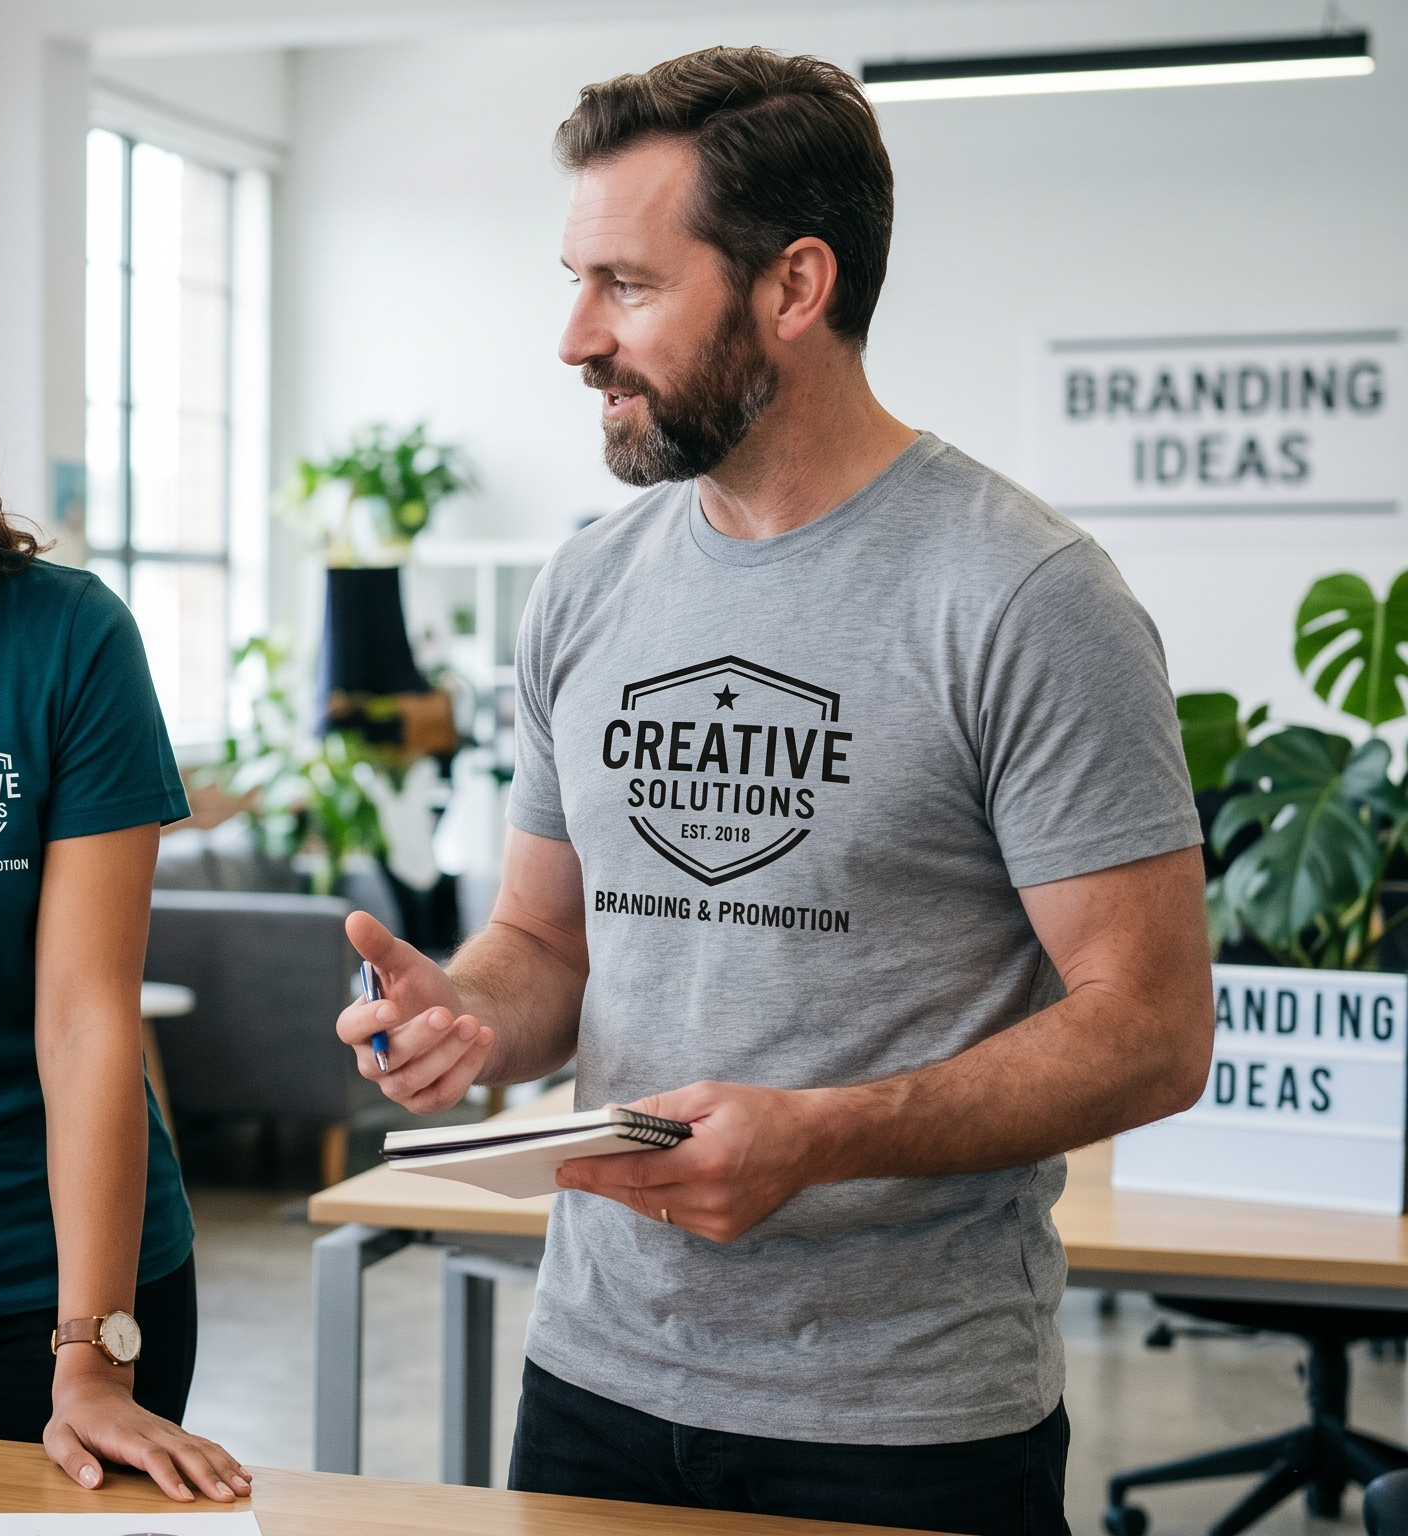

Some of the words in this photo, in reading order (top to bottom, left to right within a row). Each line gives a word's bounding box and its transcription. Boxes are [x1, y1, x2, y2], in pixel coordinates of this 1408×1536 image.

[1065, 359, 1385, 420] BRANDING
[1134, 431, 1311, 486] IDEAS
[602, 719, 853, 785] CREATIVE
[627, 777, 815, 820] SOLUTIONS
[680, 823, 711, 841] EST.
[714, 825, 751, 844] 2018
[595, 890, 691, 920] BRANDING
[697, 899, 712, 922] &
[718, 900, 850, 934] PROMOTION
[1215, 986, 1394, 1042] ANDING
[1215, 1061, 1332, 1113] DEAS
